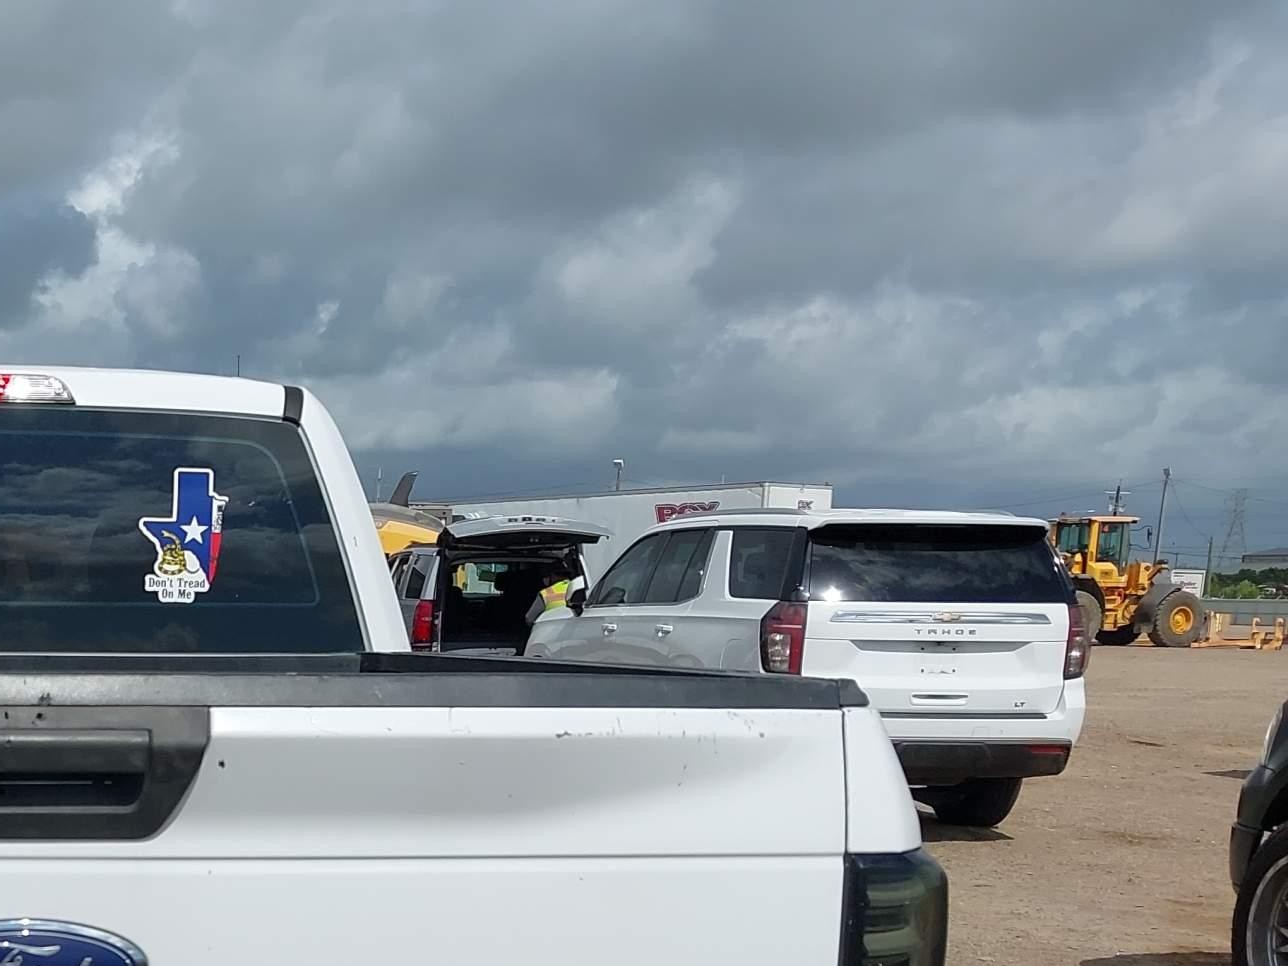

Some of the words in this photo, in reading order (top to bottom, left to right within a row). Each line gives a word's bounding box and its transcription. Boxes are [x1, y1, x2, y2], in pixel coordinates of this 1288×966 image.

[148, 577, 174, 588] Don't
[178, 577, 206, 588] Tread
[162, 588, 174, 599] On
[177, 588, 192, 599] Me
[914, 628, 977, 636] TAHOE
